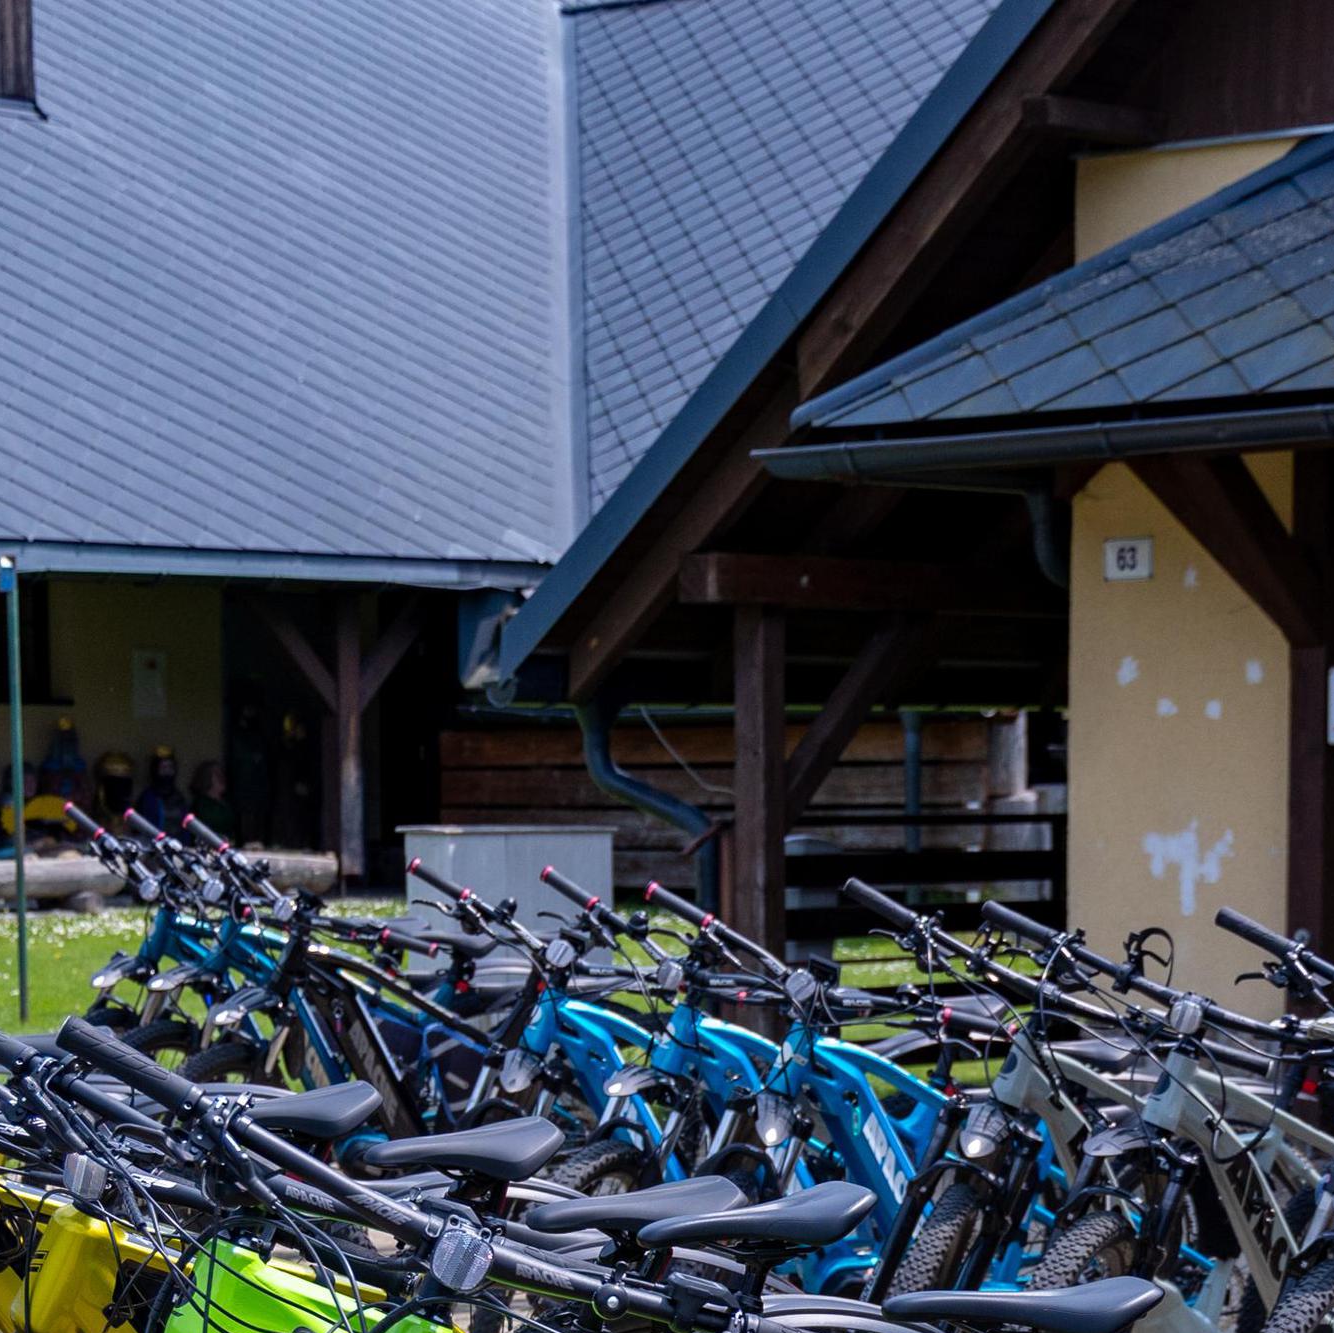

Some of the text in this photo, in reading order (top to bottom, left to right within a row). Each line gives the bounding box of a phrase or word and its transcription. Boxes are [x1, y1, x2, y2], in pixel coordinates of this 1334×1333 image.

[1116, 546, 1136, 571] 63
[285, 1185, 335, 1212] APACHE
[347, 1193, 412, 1225] APACHE
[516, 1263, 574, 1290] APACHE
